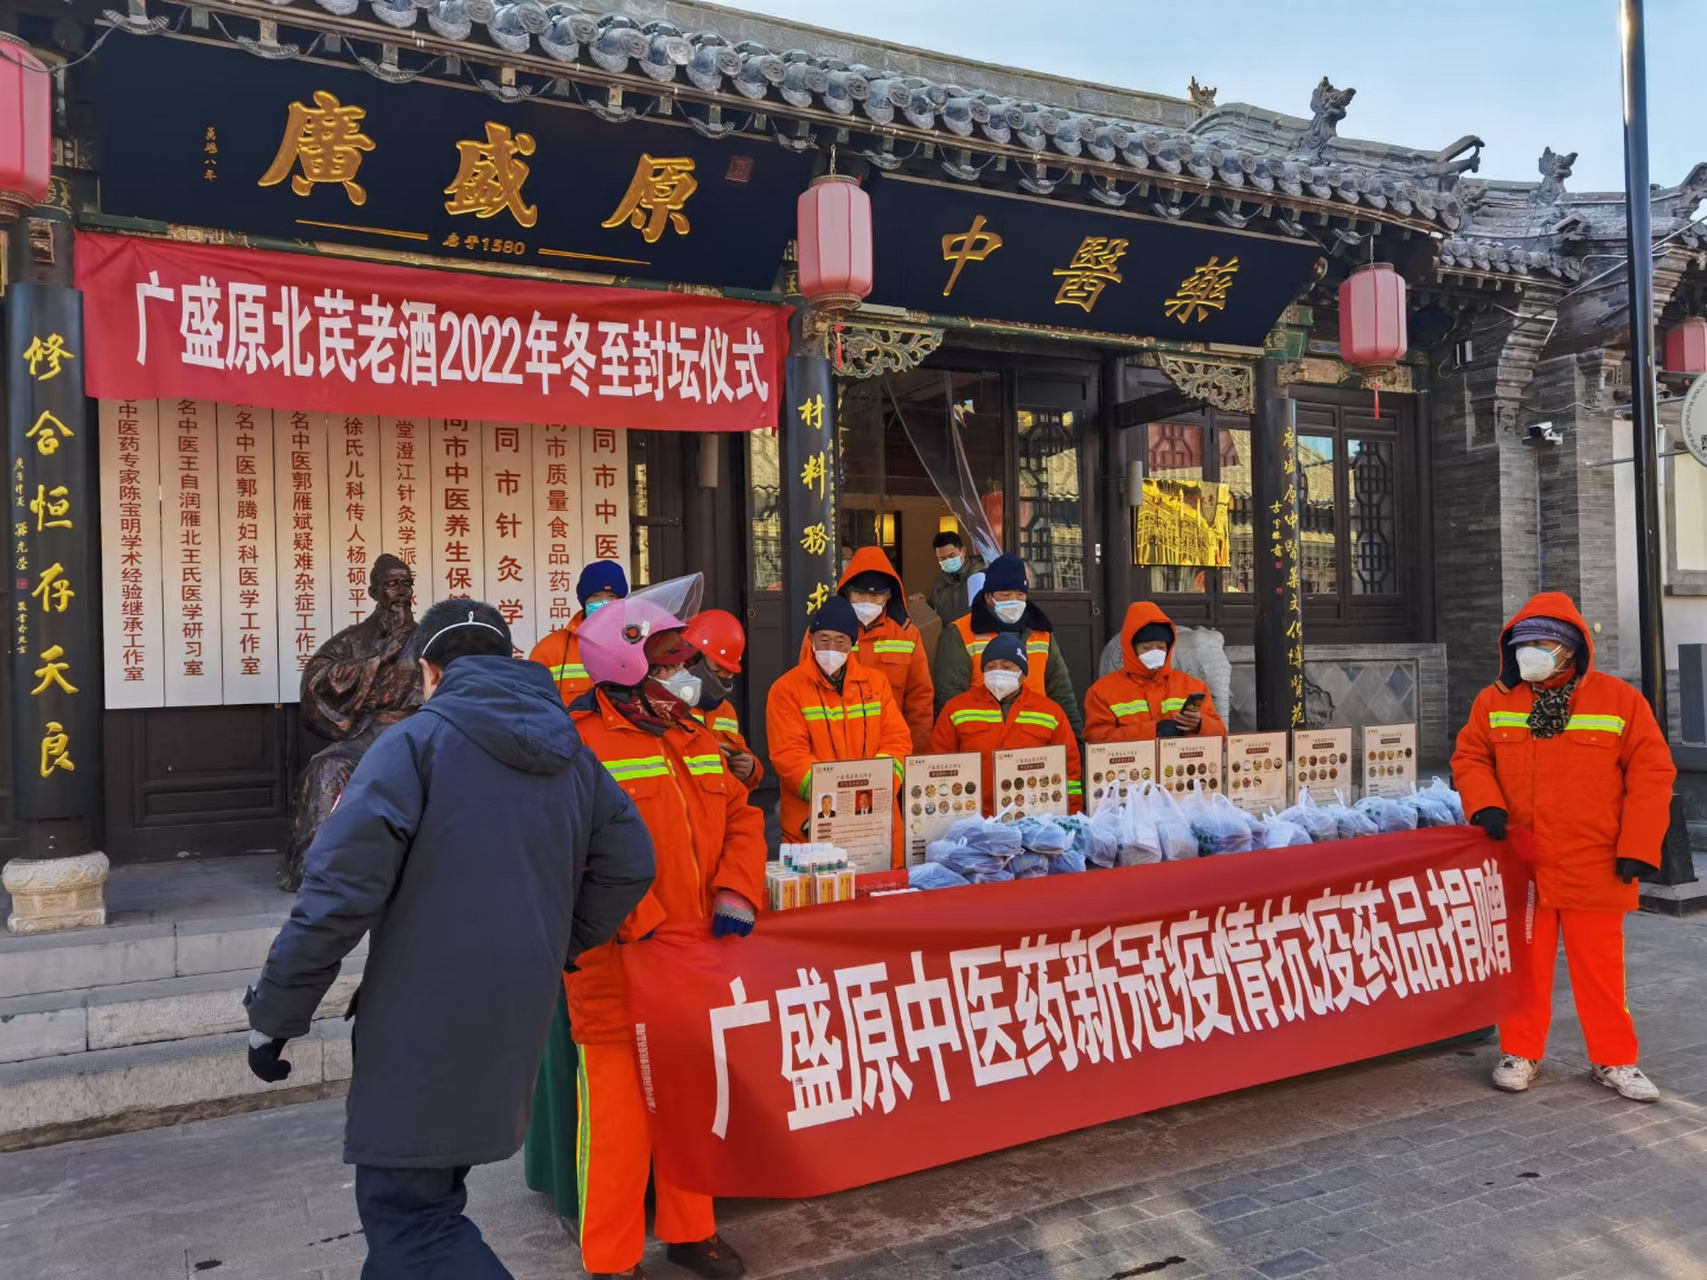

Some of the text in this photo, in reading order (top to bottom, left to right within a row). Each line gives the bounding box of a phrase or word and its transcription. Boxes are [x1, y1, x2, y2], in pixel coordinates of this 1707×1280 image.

[258, 90, 699, 244] 廣盛原
[135, 270, 769, 404] 广盛原北芪老酒2022年冬至封坛仪式
[117, 398, 145, 681] 中医药专家陈宝明学术经验继承工作室
[178, 399, 204, 676] 名中医王自润雁北王氏医学研习室
[235, 404, 261, 675] 名中医郭腾妇科医学工作室
[395, 420, 418, 615] 堂澄江针灸学派
[443, 417, 472, 600] 同市中医养生保
[708, 857, 1512, 1140] 广盛原中医药新冠疫情抗疫药品捐赠
